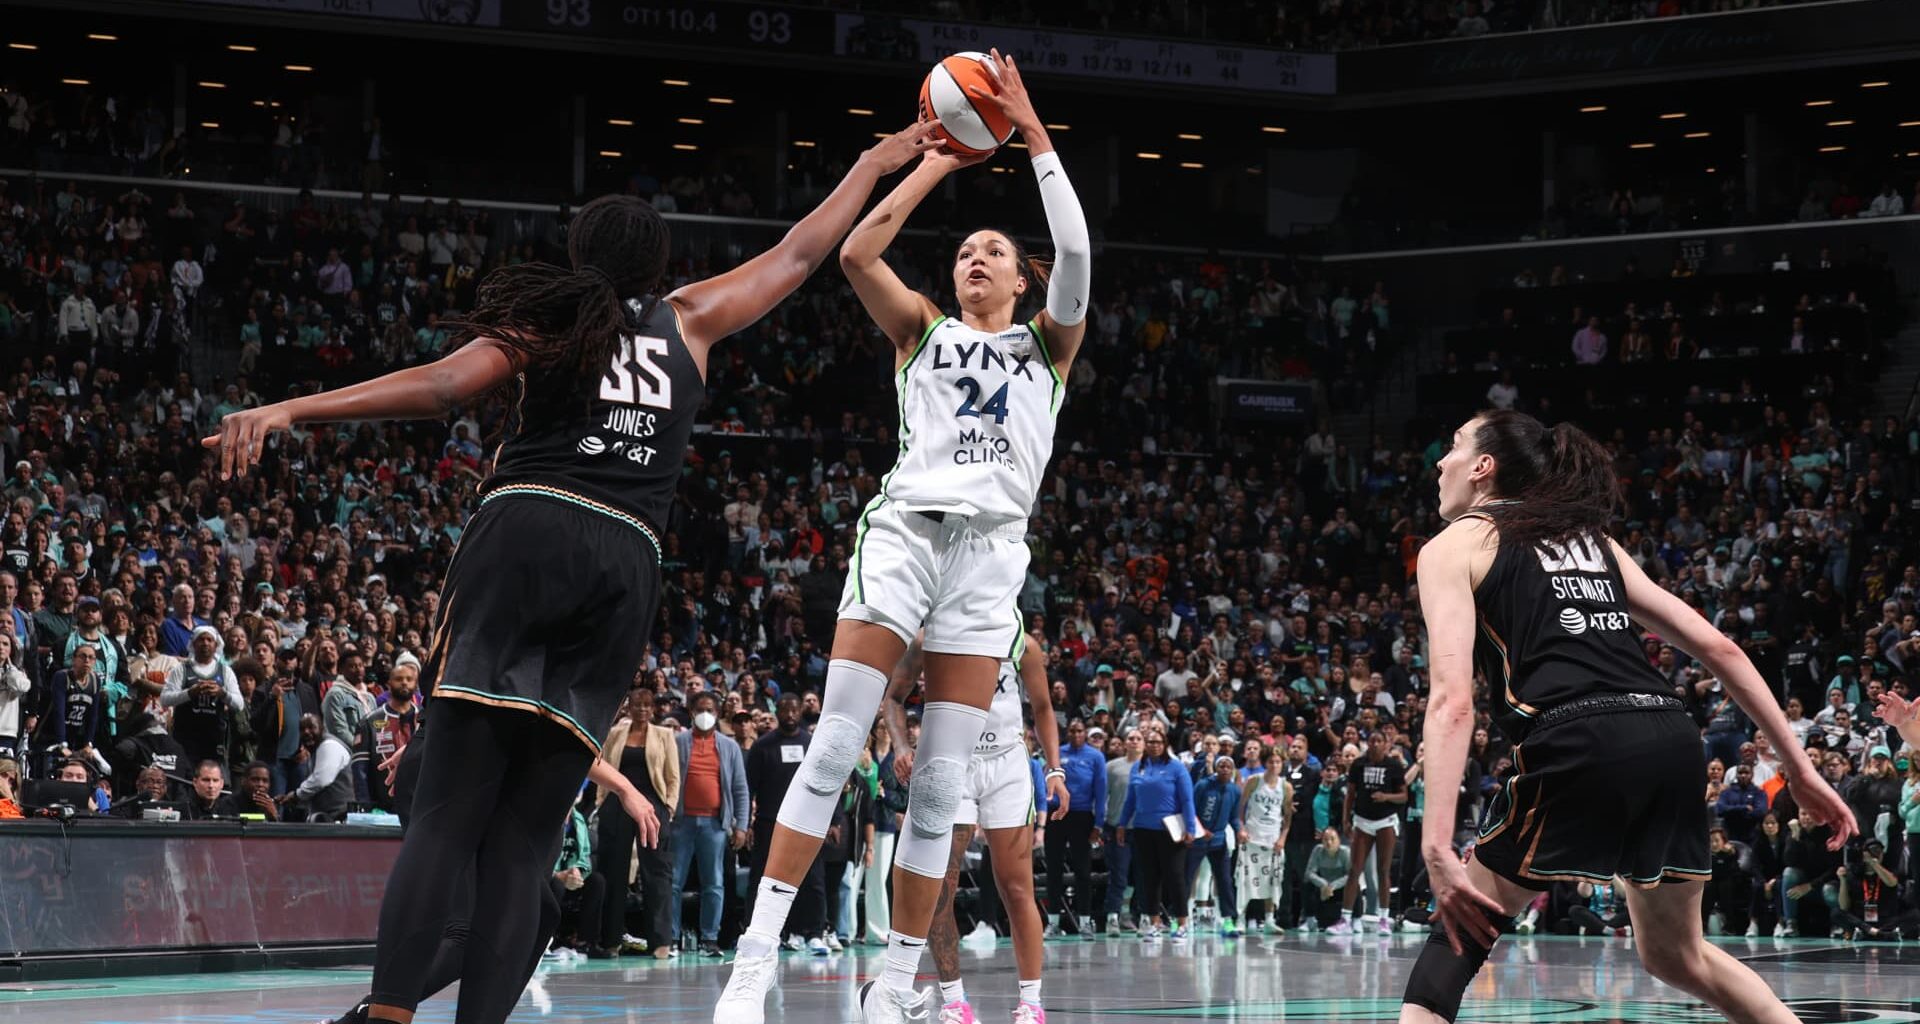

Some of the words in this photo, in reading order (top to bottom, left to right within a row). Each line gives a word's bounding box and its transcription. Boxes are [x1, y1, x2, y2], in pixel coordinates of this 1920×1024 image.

[546, 0, 592, 27] 93
[668, 9, 718, 33] 10.4
[748, 10, 792, 44] 93
[1220, 67, 1240, 81] 44
[600, 334, 671, 409] 35
[932, 341, 1034, 382] LYNX
[955, 376, 1009, 425] 24
[603, 406, 656, 437] JONES
[1552, 576, 1615, 603] STEWART
[1590, 611, 1630, 631] AT&T
[69, 705, 86, 721] 22
